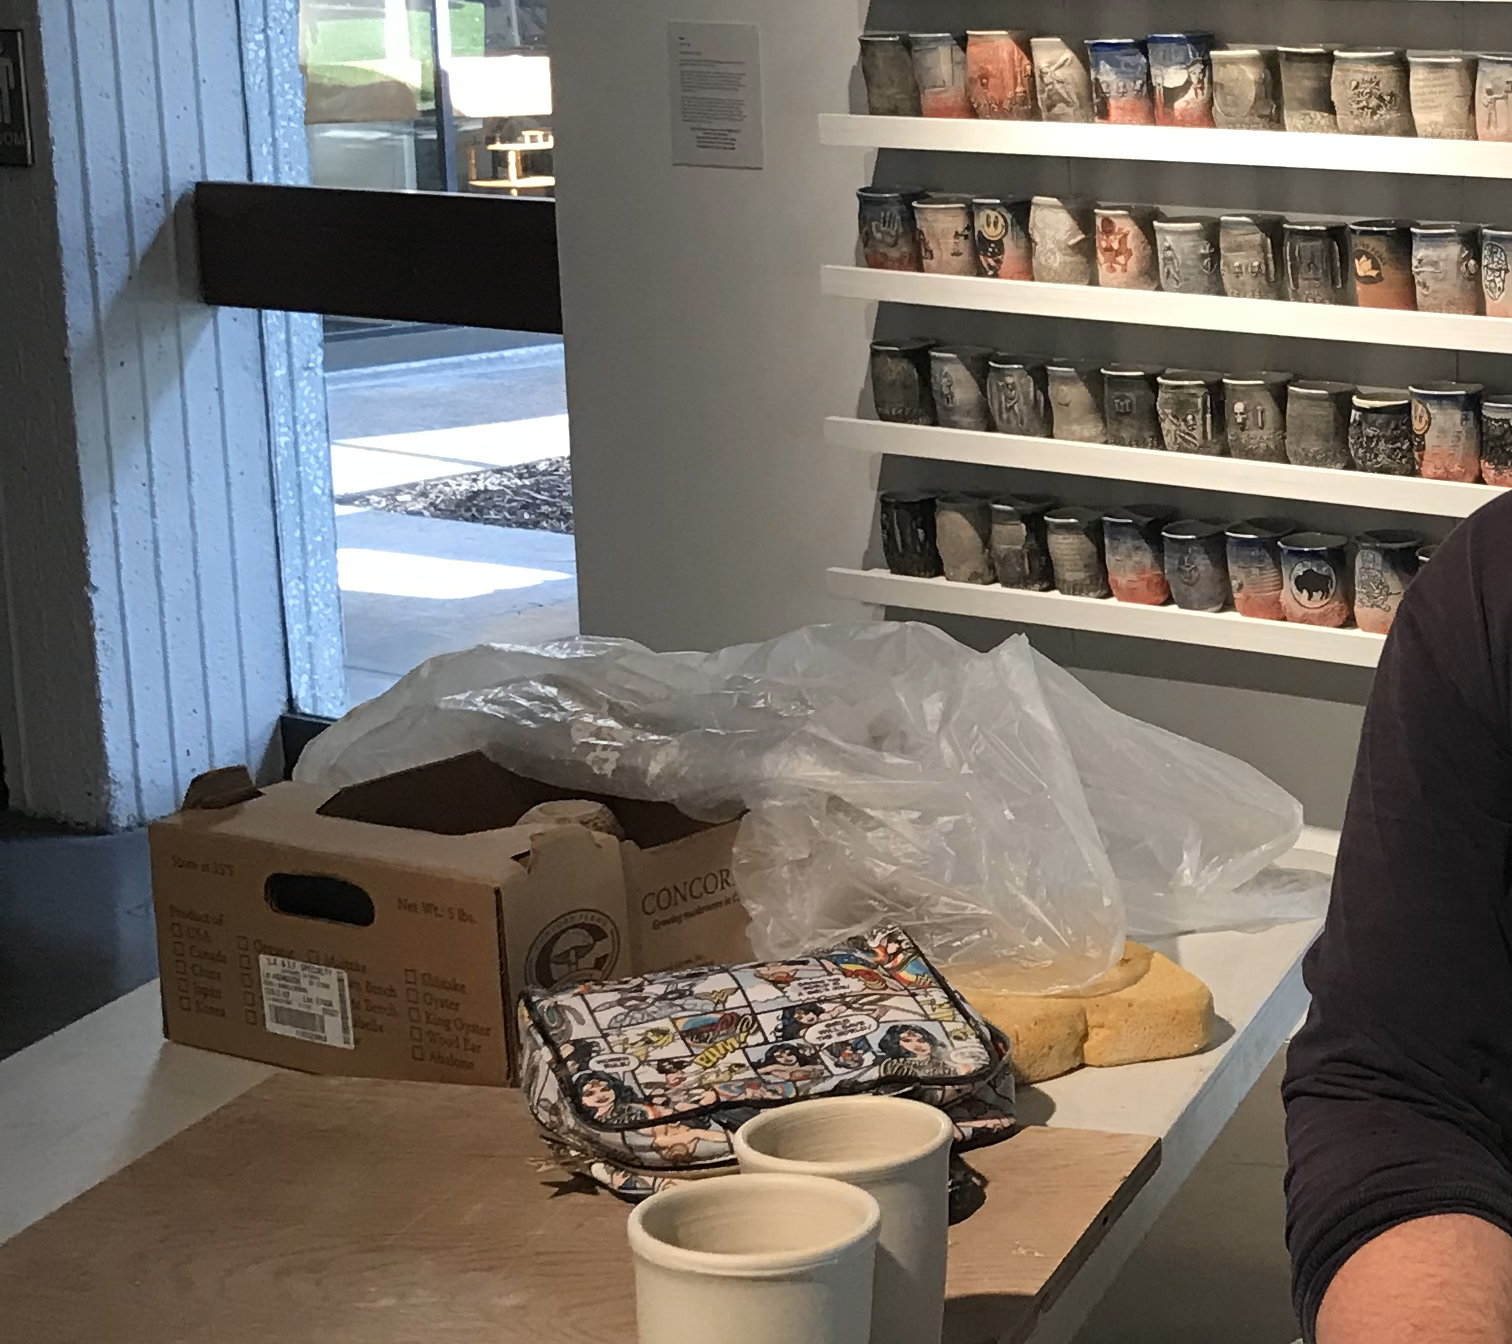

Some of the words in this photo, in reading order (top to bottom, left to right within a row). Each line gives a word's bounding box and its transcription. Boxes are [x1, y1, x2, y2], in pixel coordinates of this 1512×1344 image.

[641, 868, 735, 916] CONCOR
[397, 897, 418, 913] Net
[447, 907, 455, 919] 5
[422, 992, 460, 1011] Oyster
[425, 1011, 451, 1031] King
[453, 1018, 491, 1036] Oyster
[427, 1029, 460, 1048] Wood
[463, 1038, 482, 1054] Ear
